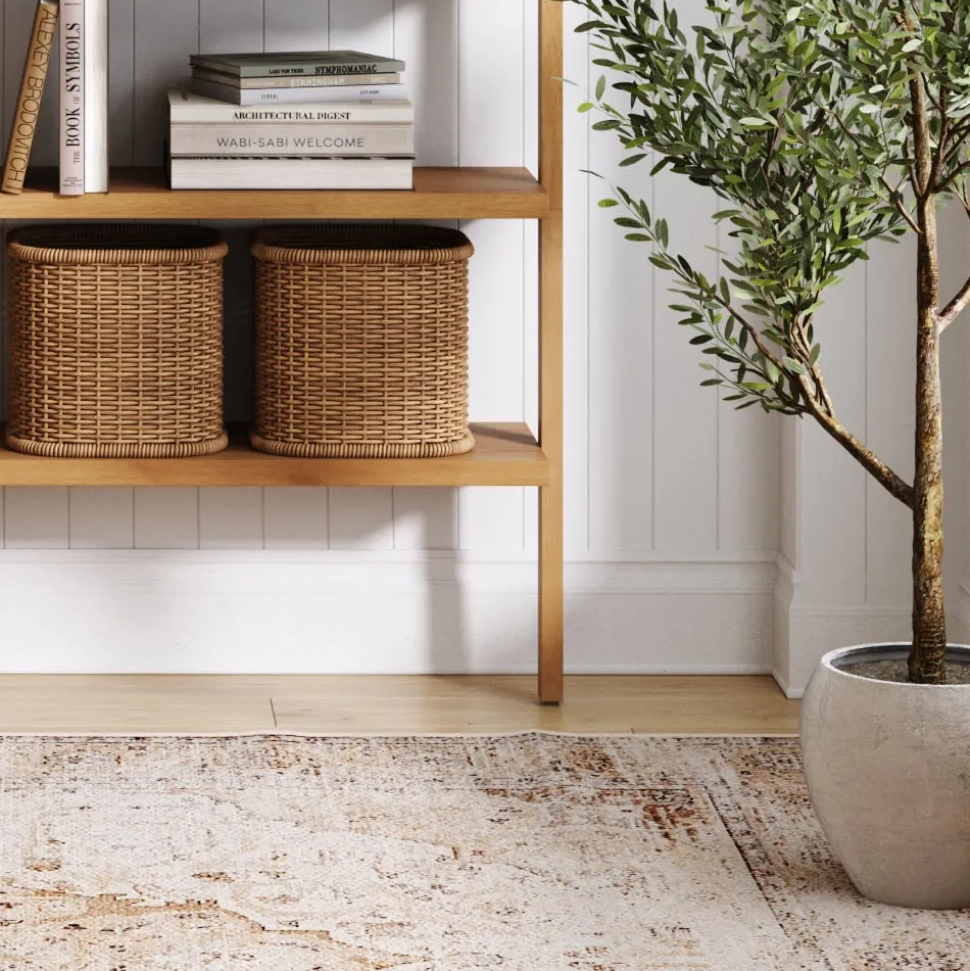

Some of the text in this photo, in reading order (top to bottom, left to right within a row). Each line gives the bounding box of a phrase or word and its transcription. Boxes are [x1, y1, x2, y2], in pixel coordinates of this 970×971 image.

[32, 8, 58, 73] ALEXEY
[65, 22, 80, 92] SYMBOLS
[315, 64, 378, 74] NYMPHOMANIAC
[65, 108, 80, 147] BOOK
[232, 111, 352, 120] ARCHITECTURAL DIGEST
[9, 77, 45, 181] BRODOVITCH
[216, 137, 365, 148] WABI-SABI WELCOME
[73, 151, 81, 164] THE
